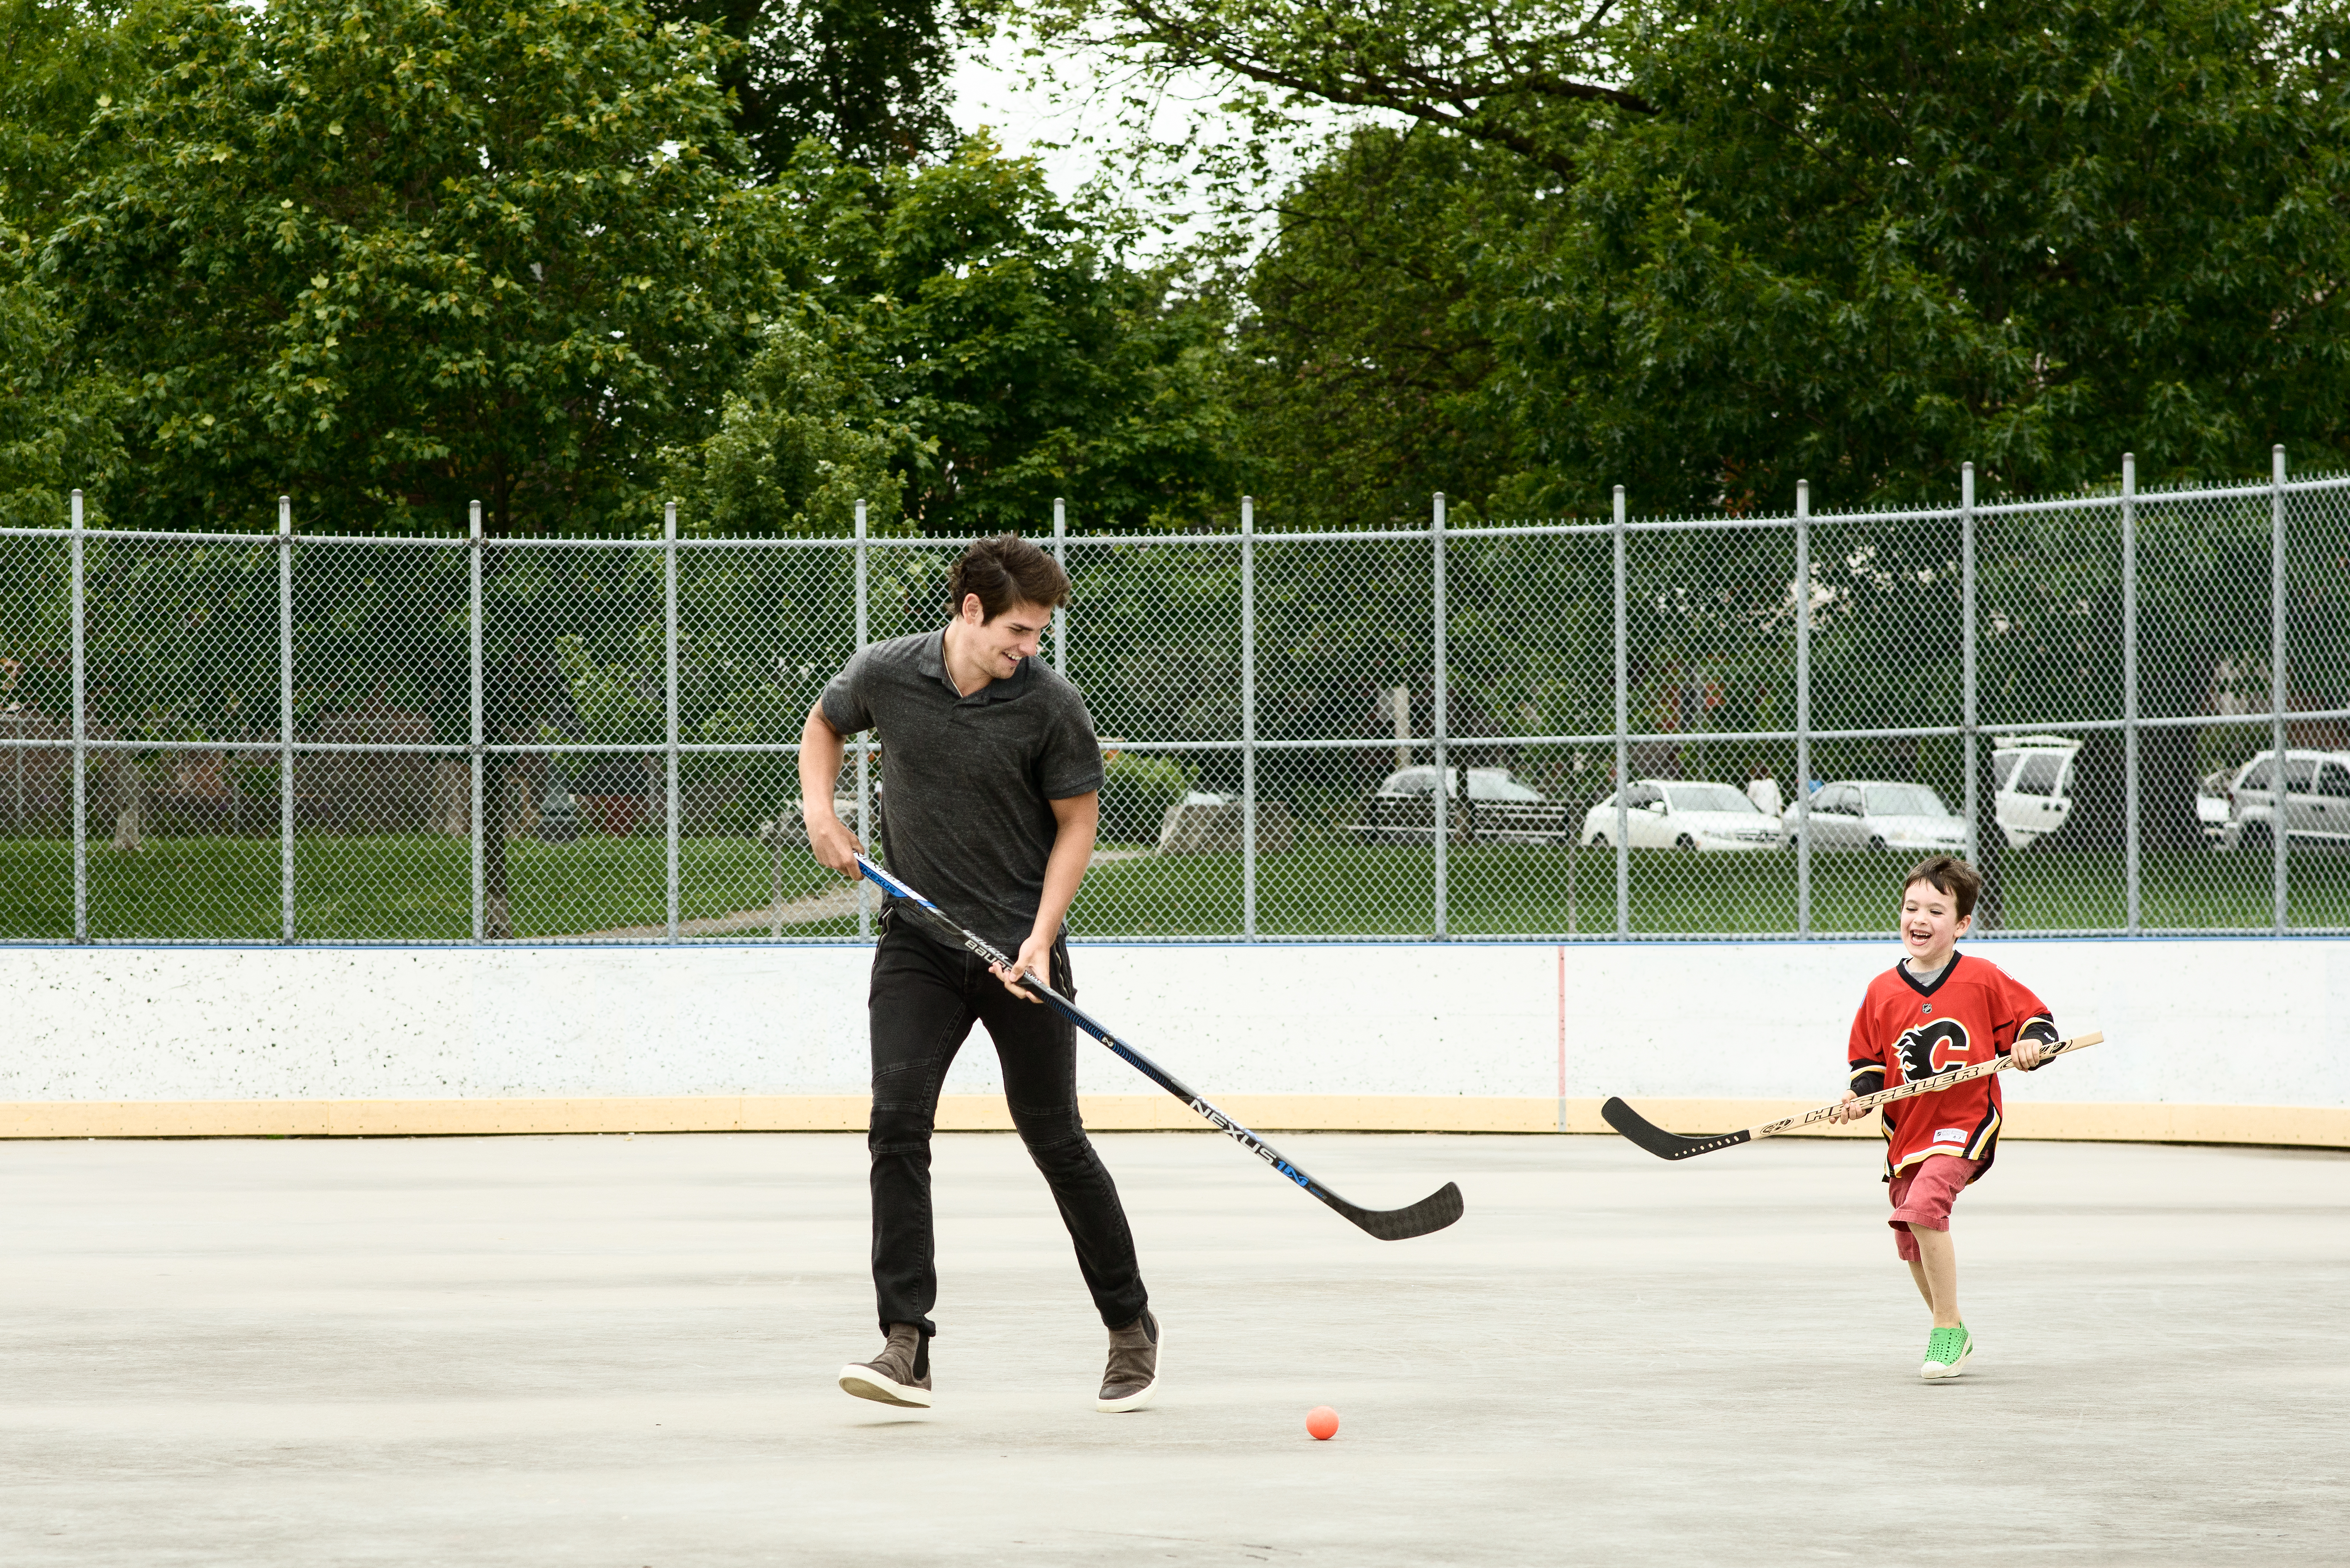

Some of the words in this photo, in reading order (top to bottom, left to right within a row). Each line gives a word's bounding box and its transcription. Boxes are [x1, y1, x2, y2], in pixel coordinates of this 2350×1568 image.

[862, 867, 896, 893] NEXUS
[1805, 1067, 1979, 1123] HESPELER
[1190, 1098, 1277, 1165] NEXUS
